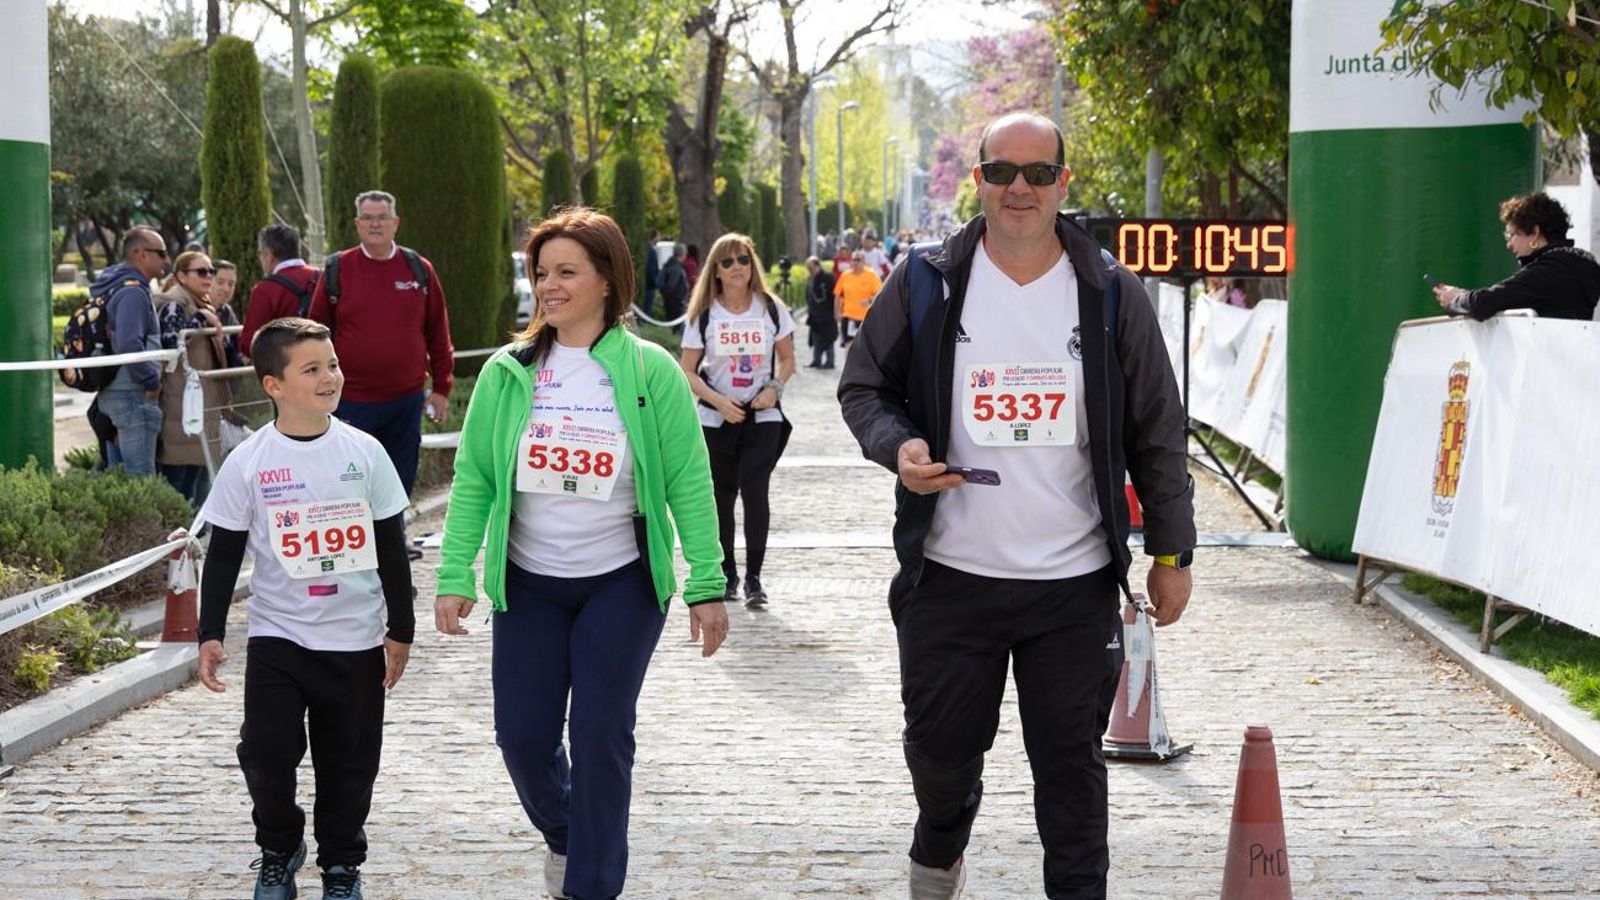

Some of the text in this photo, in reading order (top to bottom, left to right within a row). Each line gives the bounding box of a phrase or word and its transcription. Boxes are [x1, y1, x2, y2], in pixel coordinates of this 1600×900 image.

[1324, 50, 1408, 75] Junta d
[720, 331, 762, 344] 5816
[973, 393, 1066, 421] 5337
[527, 444, 614, 478] 5338
[258, 468, 292, 485] XXVII
[261, 483, 306, 494] CARRERA POPULAR
[282, 525, 366, 558] 5199
